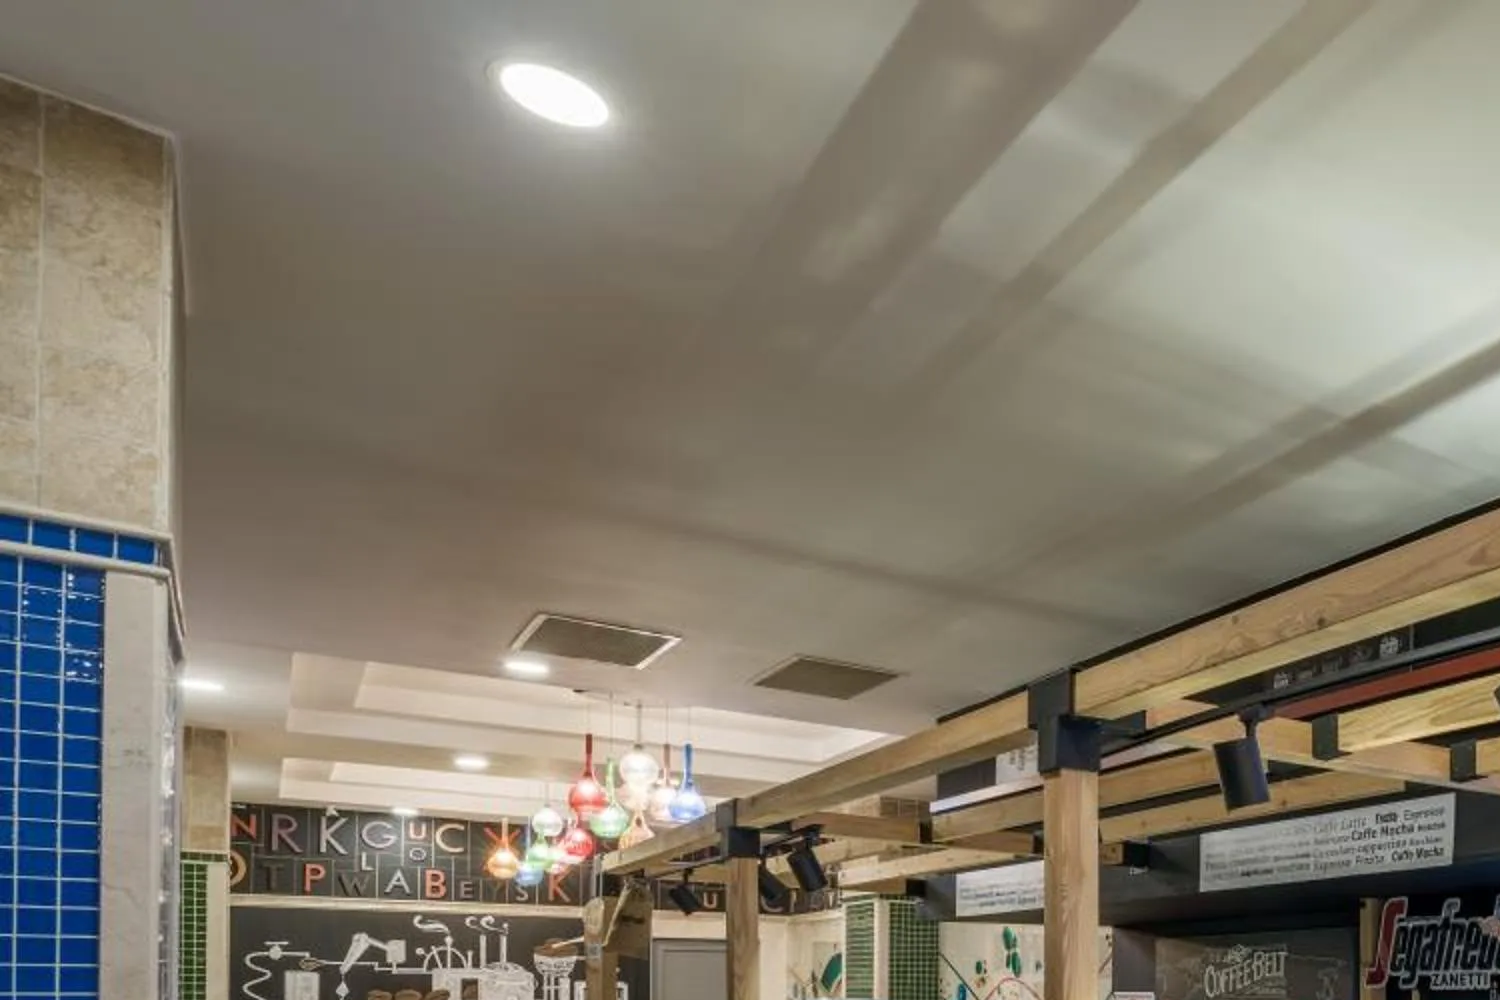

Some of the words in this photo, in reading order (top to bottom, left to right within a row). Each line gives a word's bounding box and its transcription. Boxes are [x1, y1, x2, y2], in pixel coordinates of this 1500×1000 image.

[271, 813, 303, 853] R
[319, 815, 349, 855] K
[361, 820, 397, 849] G
[435, 822, 465, 853] C
[304, 863, 326, 894] P
[384, 868, 413, 895] A
[424, 868, 447, 899] B
[1430, 972, 1492, 991] ZANETTI
